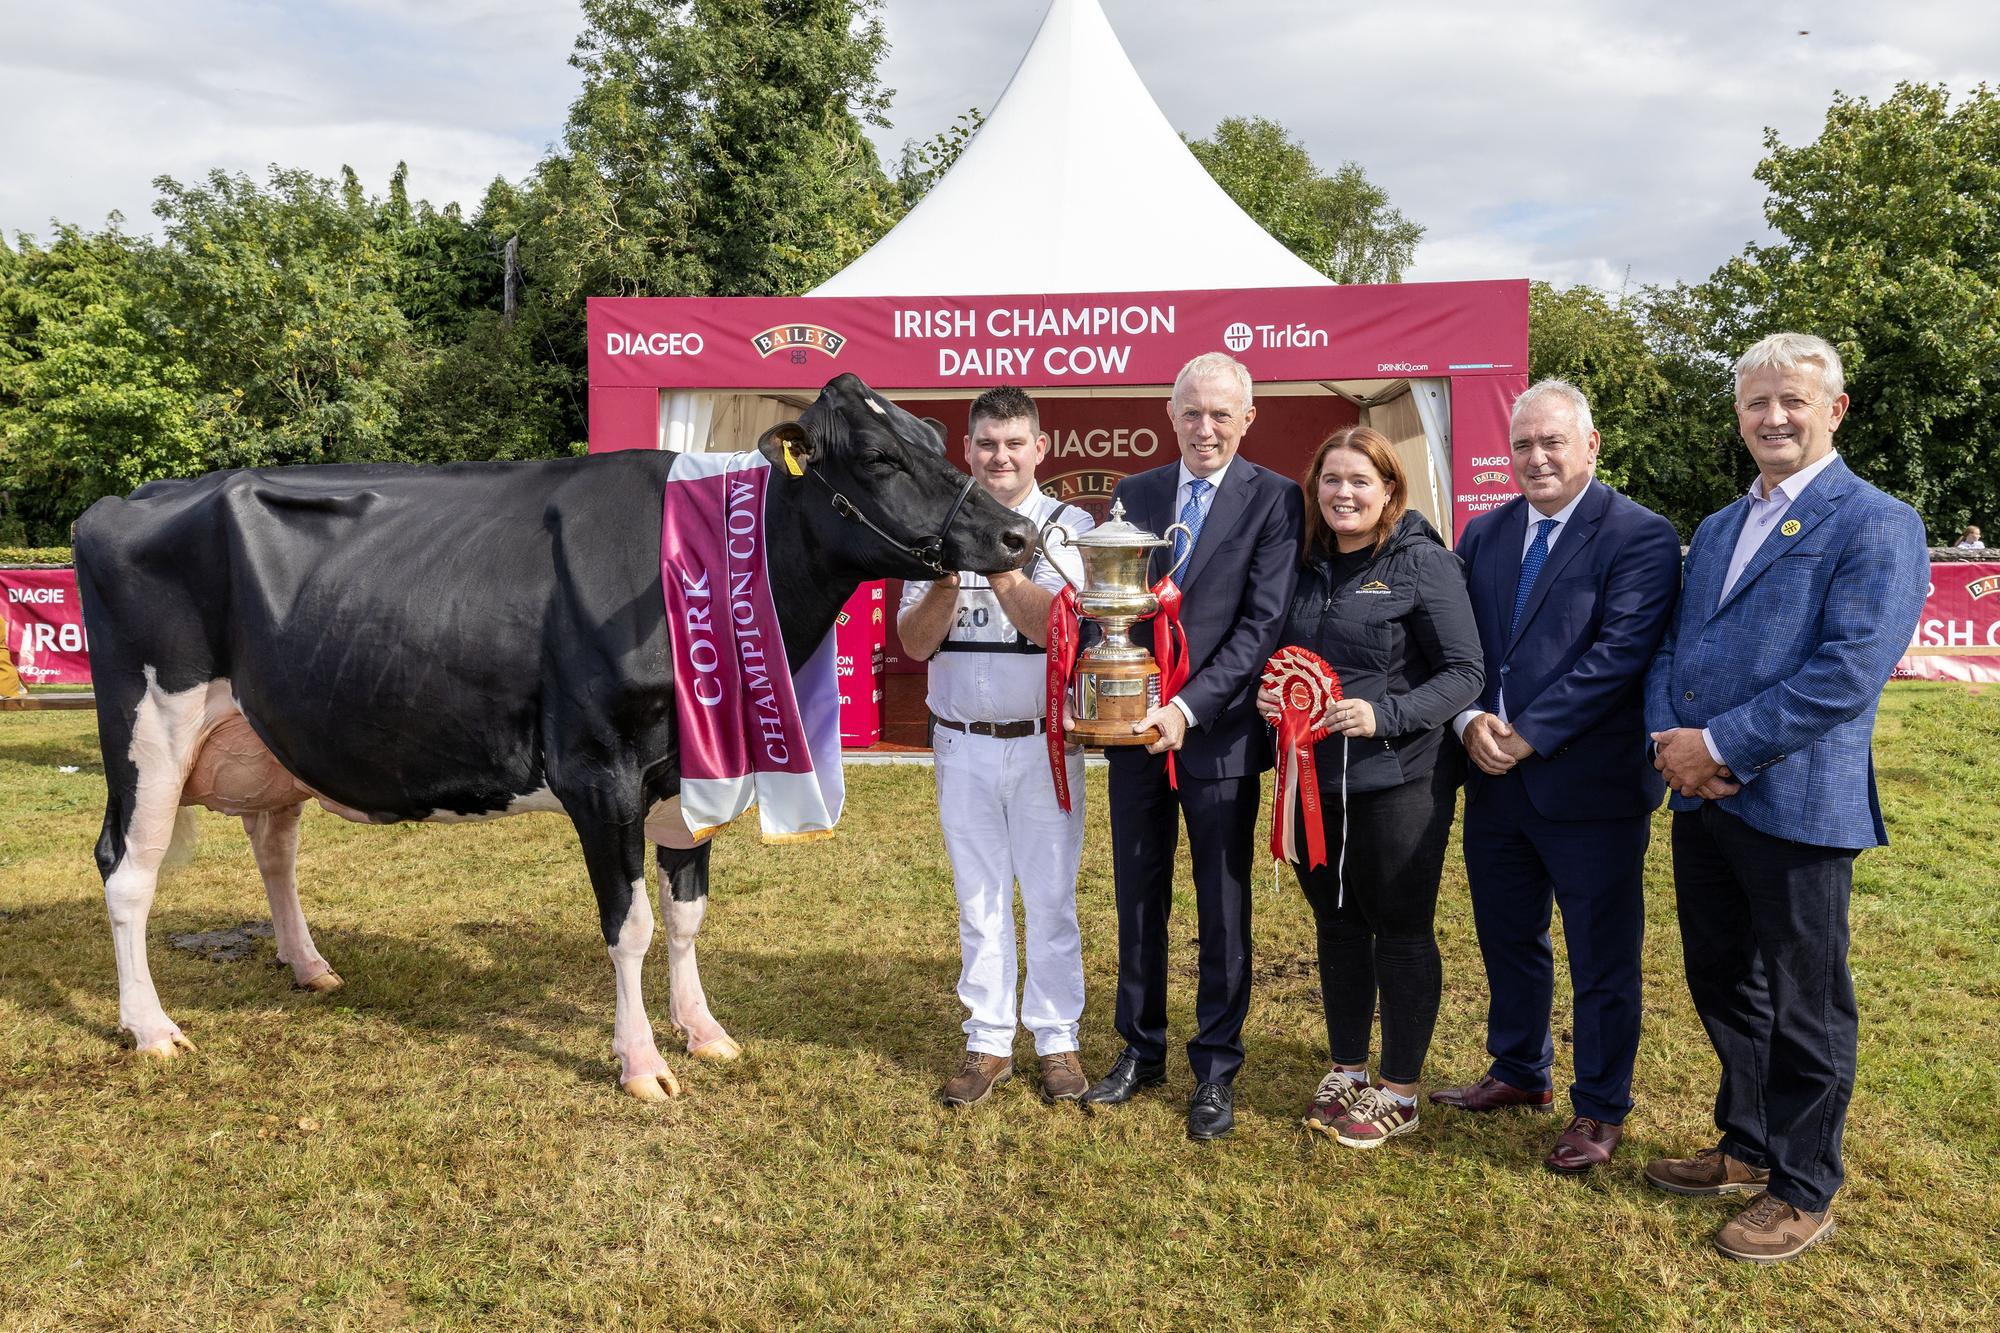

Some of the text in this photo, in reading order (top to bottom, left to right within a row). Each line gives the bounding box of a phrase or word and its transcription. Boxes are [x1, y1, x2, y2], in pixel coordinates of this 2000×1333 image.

[894, 306, 1175, 338] IRISH CHAMPION
[607, 333, 704, 355] DIAGEO
[759, 327, 837, 352] BAILEYS
[1255, 323, 1328, 348] Tirlán
[939, 346, 1131, 376] DAIRY COW
[1471, 456, 1510, 467] DIAGEO
[1043, 475, 1120, 499] BAILE
[1457, 493, 1522, 502] IRISH CHAMPIO
[1469, 503, 1492, 511] DAIRY
[729, 480, 789, 764] CHAMPION COW
[957, 606, 989, 628] 20
[683, 567, 722, 706] CORK
[837, 667, 854, 676] OW
